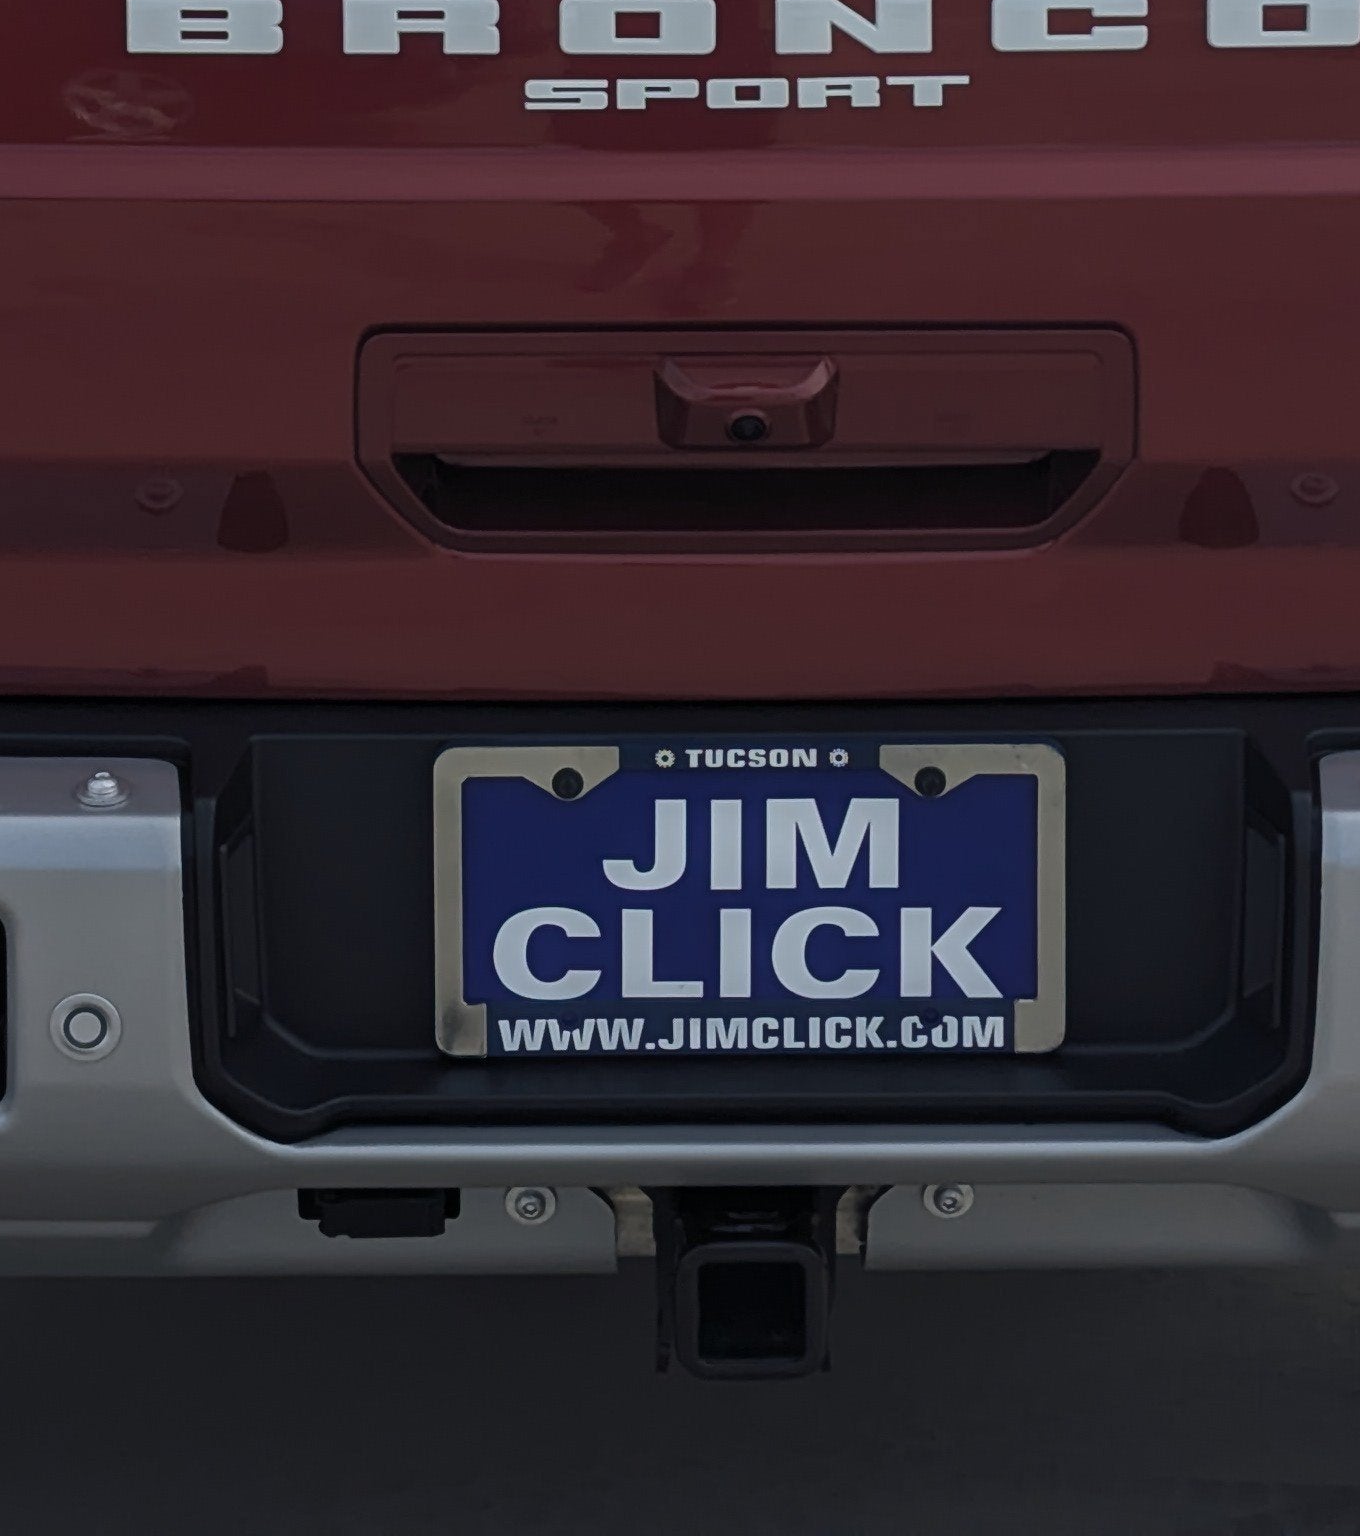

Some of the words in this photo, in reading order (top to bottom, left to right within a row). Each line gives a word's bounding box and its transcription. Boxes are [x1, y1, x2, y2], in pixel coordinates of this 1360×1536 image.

[523, 75, 970, 111] SPORT
[684, 748, 818, 768] TUCSON
[602, 797, 900, 891] JIM
[492, 906, 1003, 1000] CLICK
[497, 1015, 1005, 1052] WWW.JIMCLICK.COM
